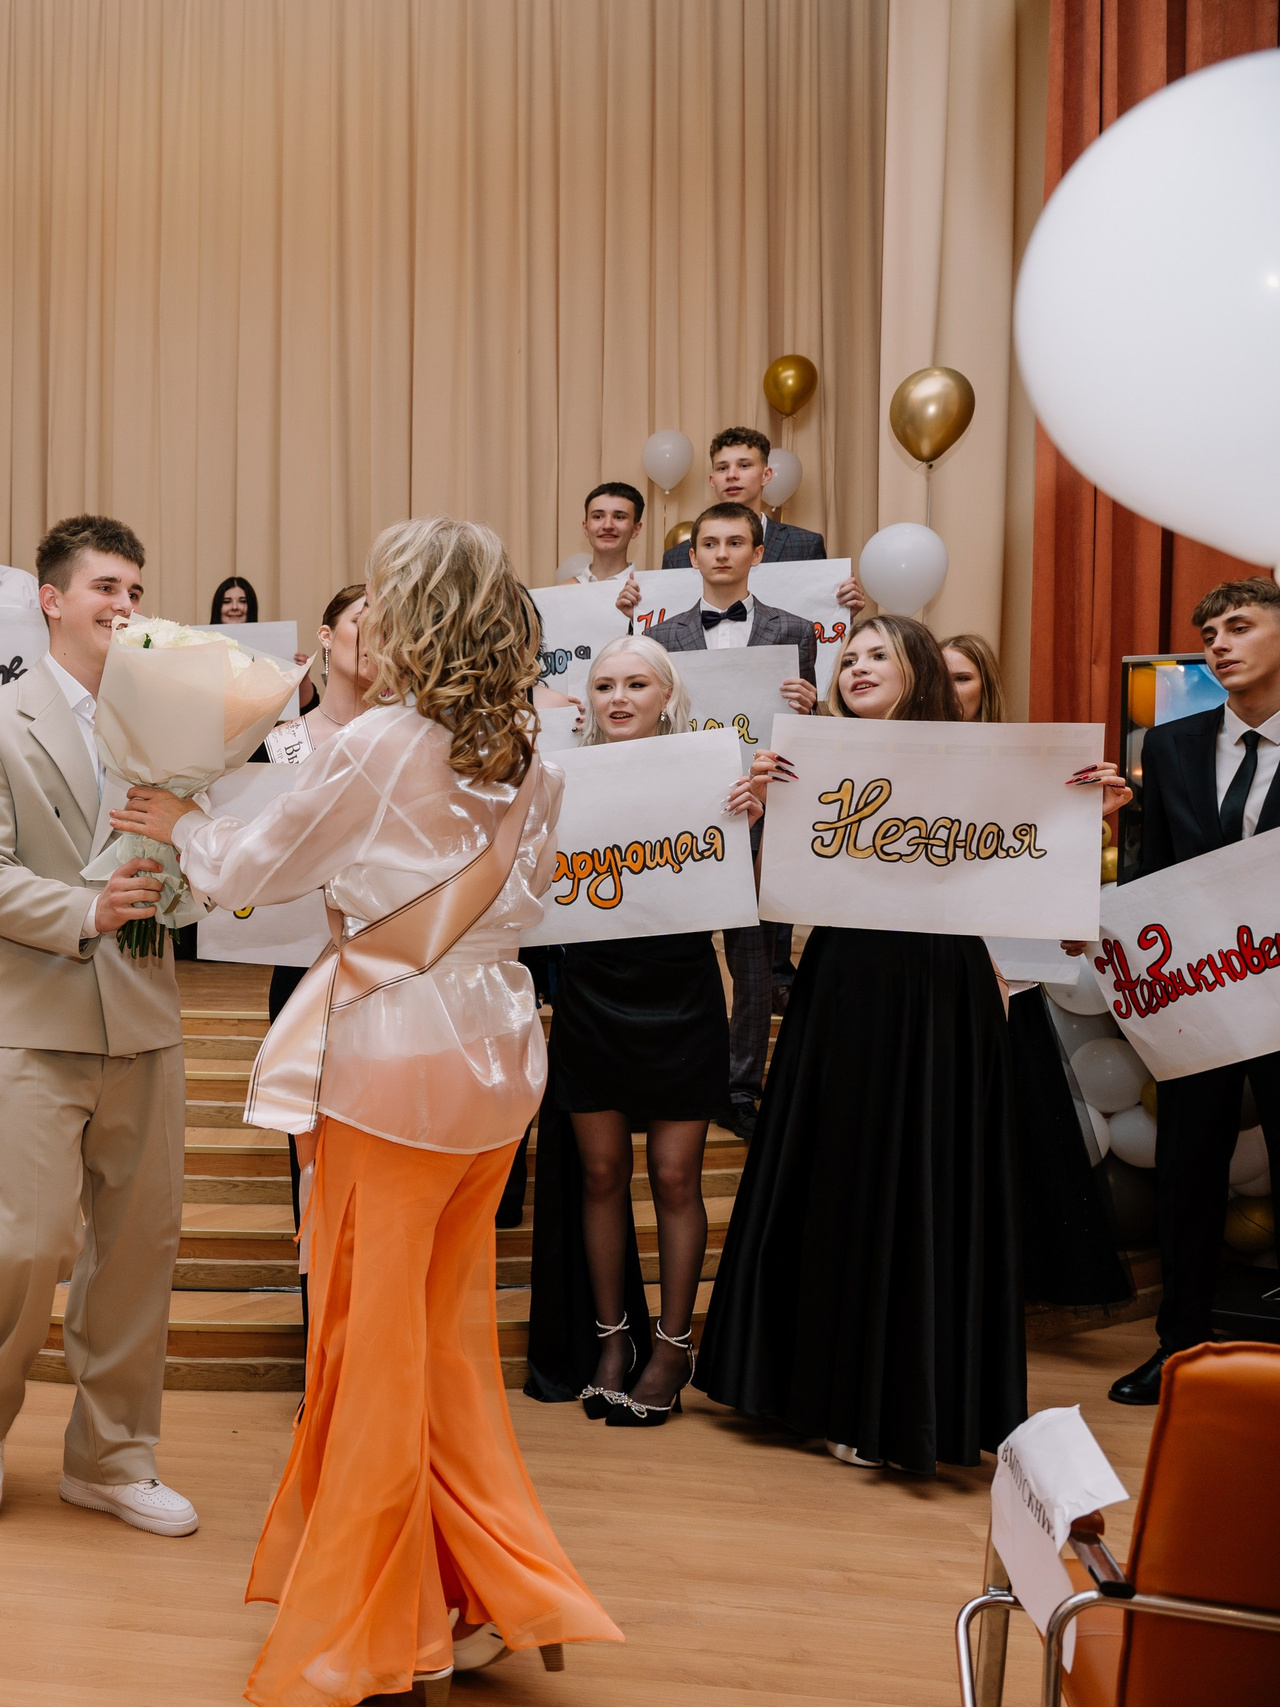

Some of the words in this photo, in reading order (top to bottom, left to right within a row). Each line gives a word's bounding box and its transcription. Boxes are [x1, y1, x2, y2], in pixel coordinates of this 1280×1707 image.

[811, 778, 1047, 866] Нежная
[547, 825, 725, 909] арующая
[1094, 923, 1280, 1019] Необыкнове
